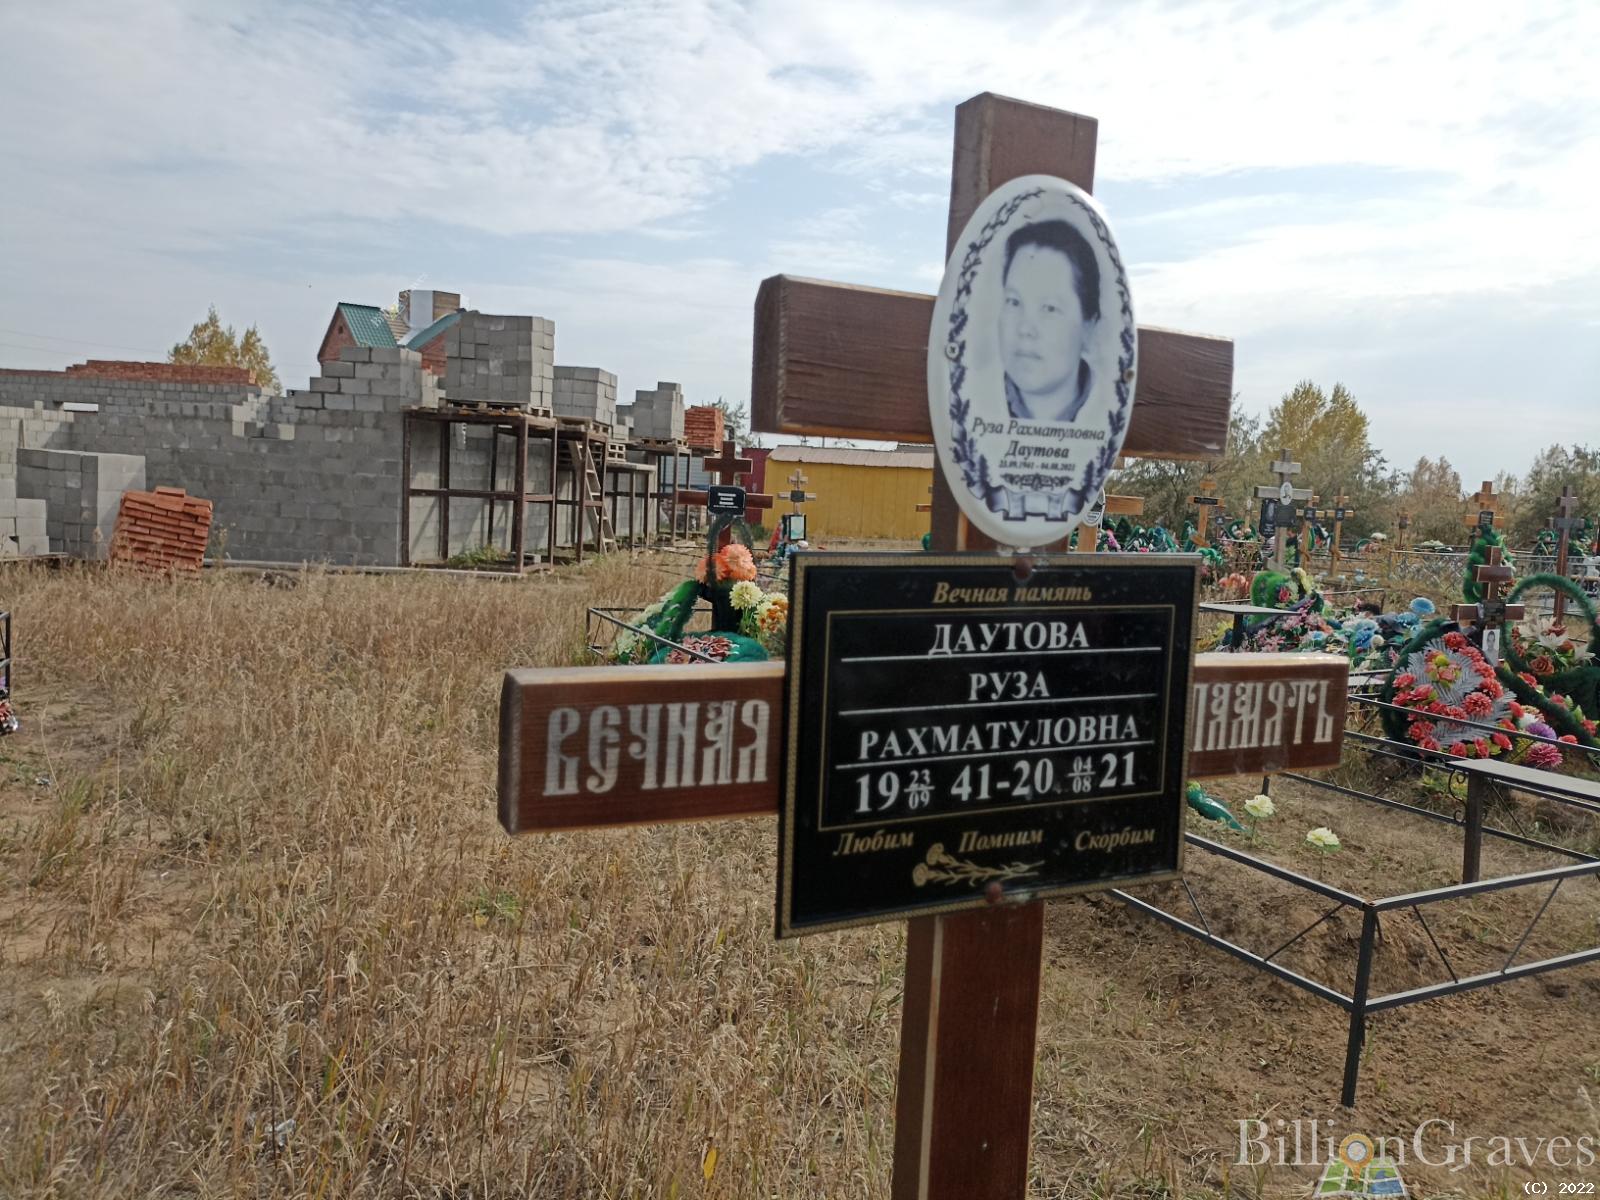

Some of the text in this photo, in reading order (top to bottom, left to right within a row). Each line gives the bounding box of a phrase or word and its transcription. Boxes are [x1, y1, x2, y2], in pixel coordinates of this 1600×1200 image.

[972, 417, 1106, 442] Руза Рахматуловна
[1005, 440, 1070, 460] Даутова
[932, 582, 1092, 603] Вечная память
[928, 622, 1090, 660] ДАУТОВА
[968, 671, 1051, 702] РУЗА
[859, 715, 1139, 760] РАХМАТУЛОВНА
[855, 771, 900, 813] 19
[1099, 751, 1136, 788] 21
[833, 827, 1156, 856] Любим Помним Скорбим
